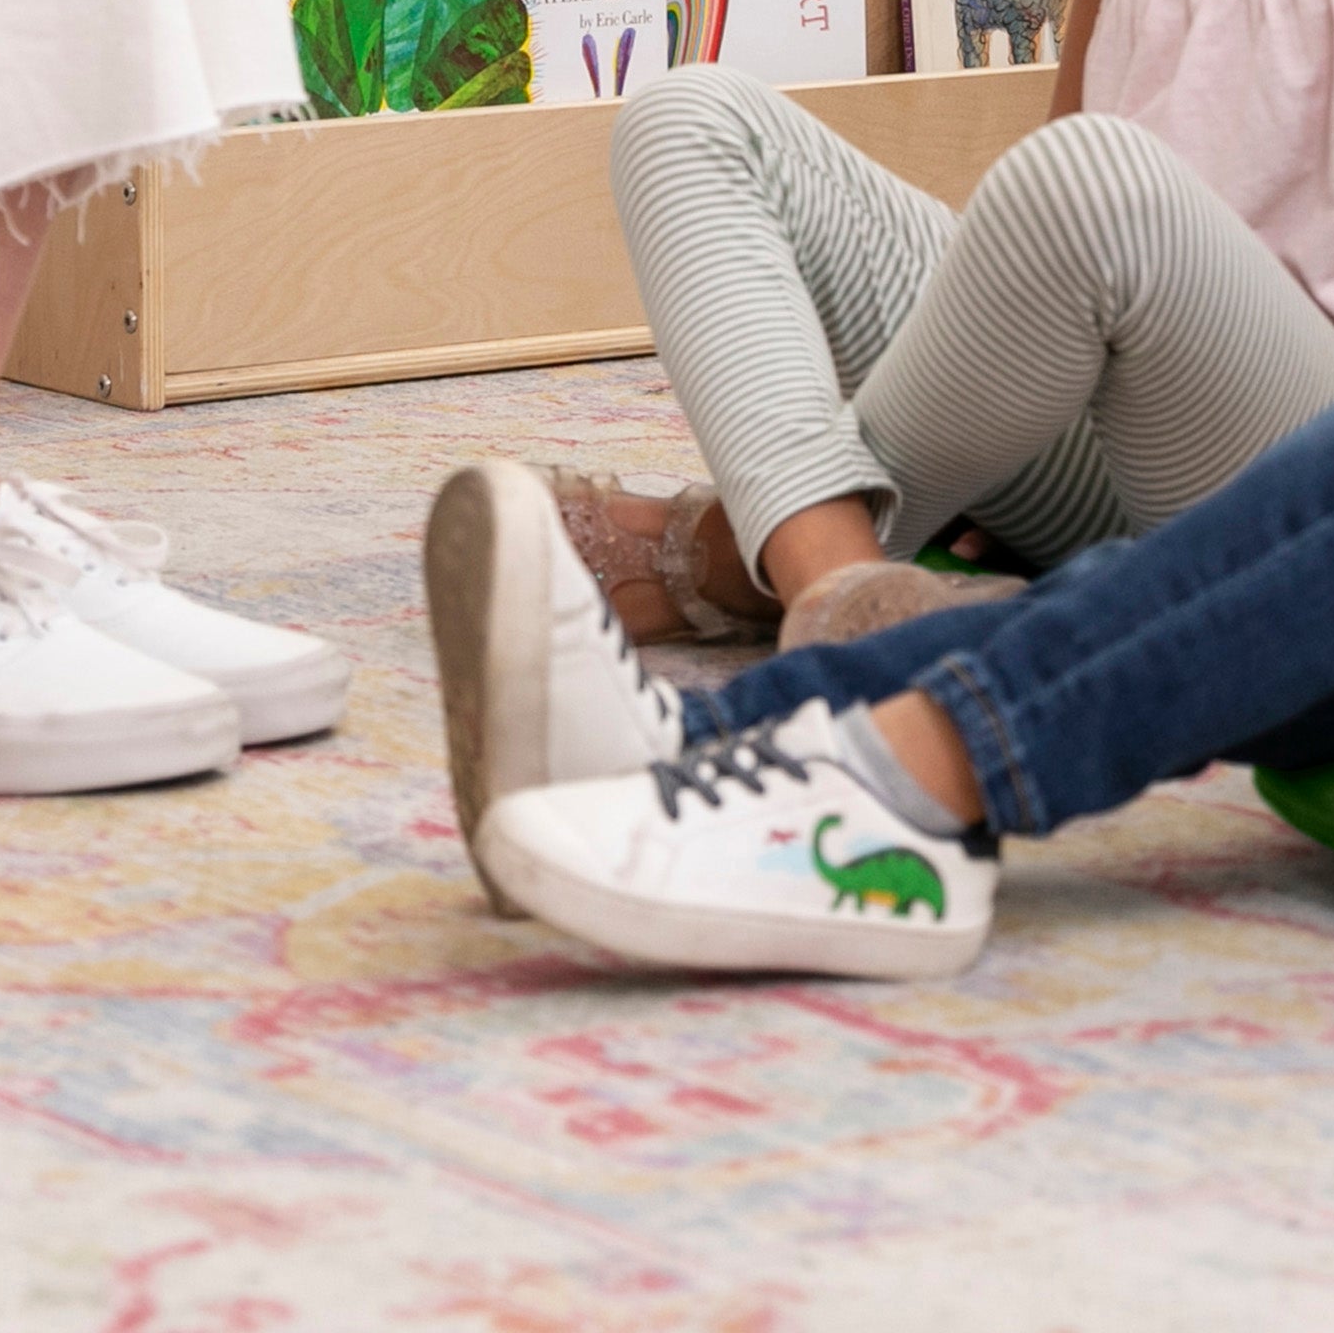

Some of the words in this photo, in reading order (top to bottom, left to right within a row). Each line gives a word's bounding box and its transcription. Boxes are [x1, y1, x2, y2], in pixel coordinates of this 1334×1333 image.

[579, 14, 593, 33] by
[596, 12, 620, 28] Eric
[622, 9, 653, 25] Carle
